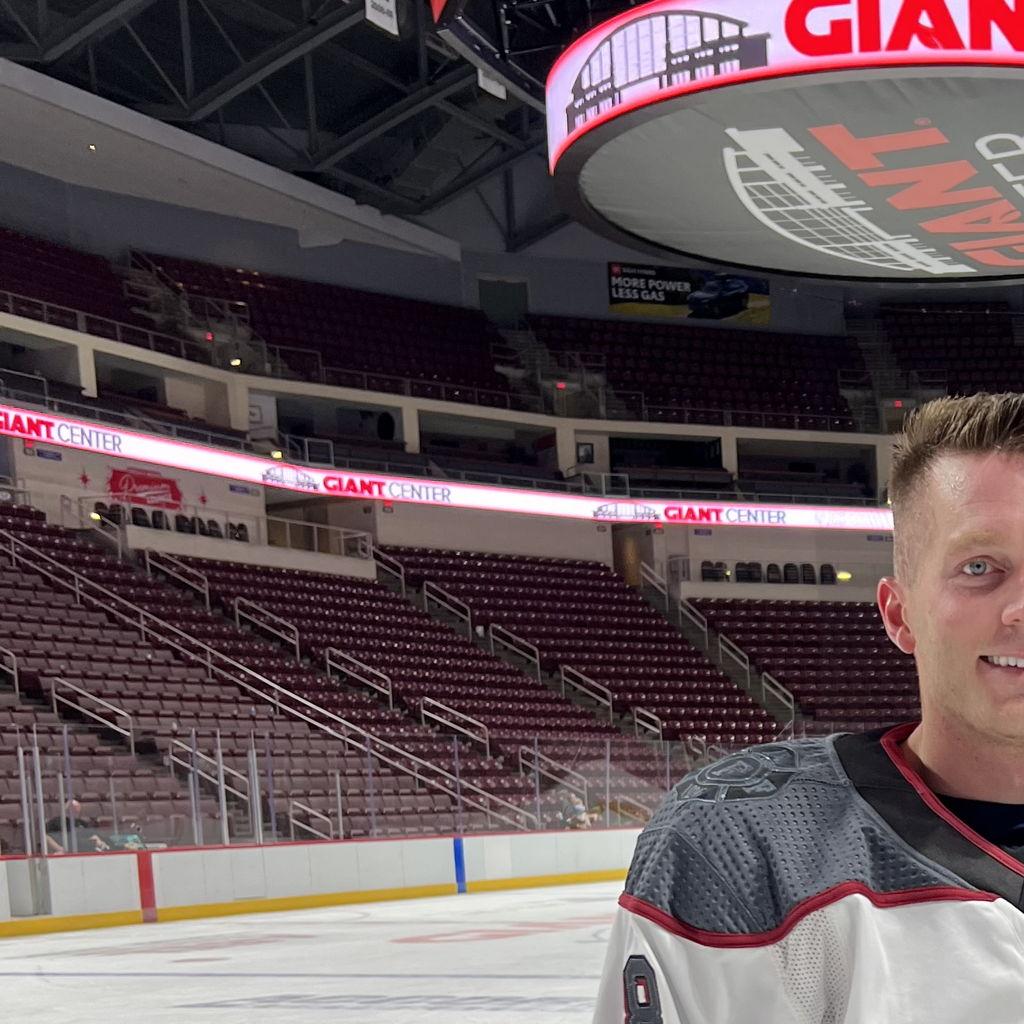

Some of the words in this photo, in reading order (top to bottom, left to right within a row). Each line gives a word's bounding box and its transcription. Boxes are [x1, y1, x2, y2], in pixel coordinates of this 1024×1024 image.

[611, 277, 646, 289] MORE
[648, 280, 691, 292] POWER
[611, 288, 638, 299] LESS
[641, 291, 665, 301] GAS
[57, 423, 122, 452] CENTER
[323, 475, 386, 496] GIANT
[388, 482, 452, 503] CENTER
[664, 506, 723, 523] GIANT
[725, 508, 786, 525] CENTER
